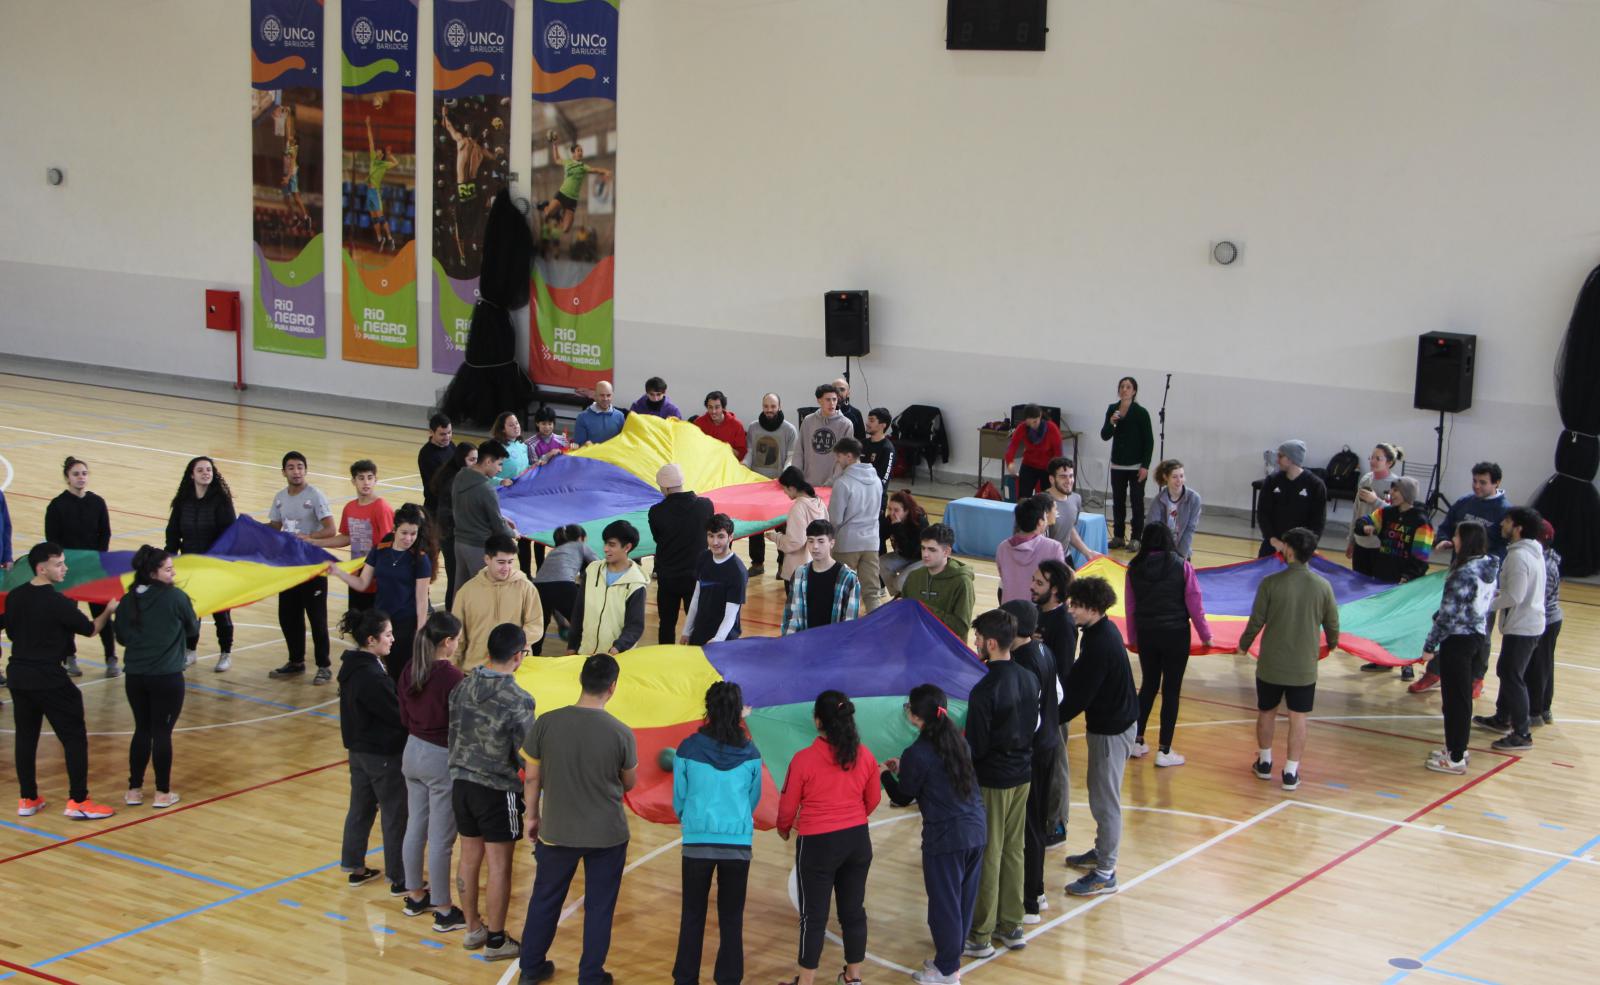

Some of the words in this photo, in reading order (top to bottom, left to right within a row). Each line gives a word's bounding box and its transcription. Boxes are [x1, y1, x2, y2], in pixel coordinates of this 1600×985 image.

[283, 27, 315, 40] UNCo
[375, 29, 409, 42] UNCo
[469, 31, 505, 45] UNCo
[570, 33, 607, 47] UNCo
[376, 42, 409, 50] BARILOCHE
[470, 45, 505, 53] BARILOCHE
[571, 47, 607, 55] BARILOCHE
[275, 311, 315, 326] NEGRO
[363, 320, 407, 335] NEGRO
[553, 341, 601, 358] NEGRO
